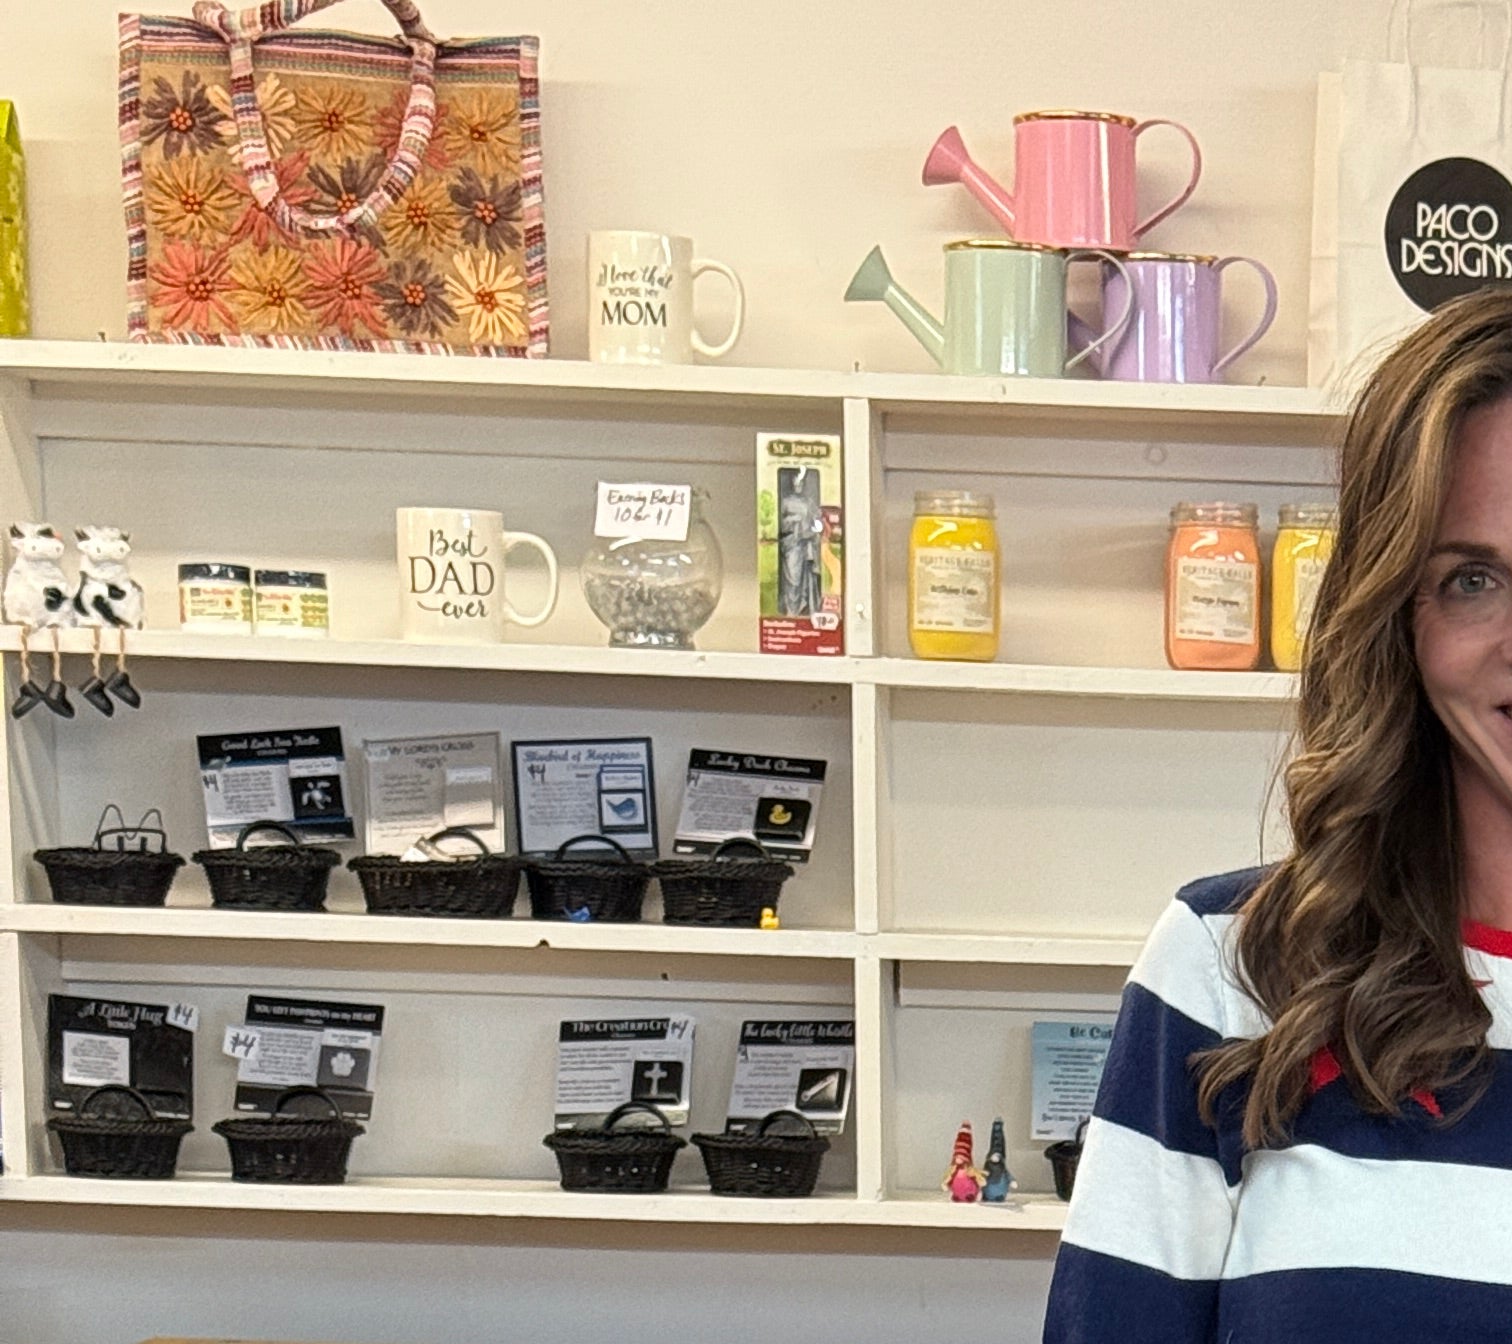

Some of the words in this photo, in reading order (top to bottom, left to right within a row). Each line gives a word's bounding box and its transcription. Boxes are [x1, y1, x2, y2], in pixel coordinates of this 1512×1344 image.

[1416, 201, 1499, 241] PACO
[610, 264, 637, 284] love
[640, 265, 673, 289] that
[601, 300, 667, 328] MOM
[429, 529, 488, 558] Best
[408, 556, 495, 596] DAD
[428, 599, 489, 620] ever
[571, 751, 582, 763] of
[585, 748, 642, 764] Happiness
[98, 1003, 130, 1019] Little
[128, 1006, 165, 1026] Hug
[173, 1002, 194, 1026] $4
[572, 1021, 595, 1033] The
[230, 1031, 257, 1058] $4
